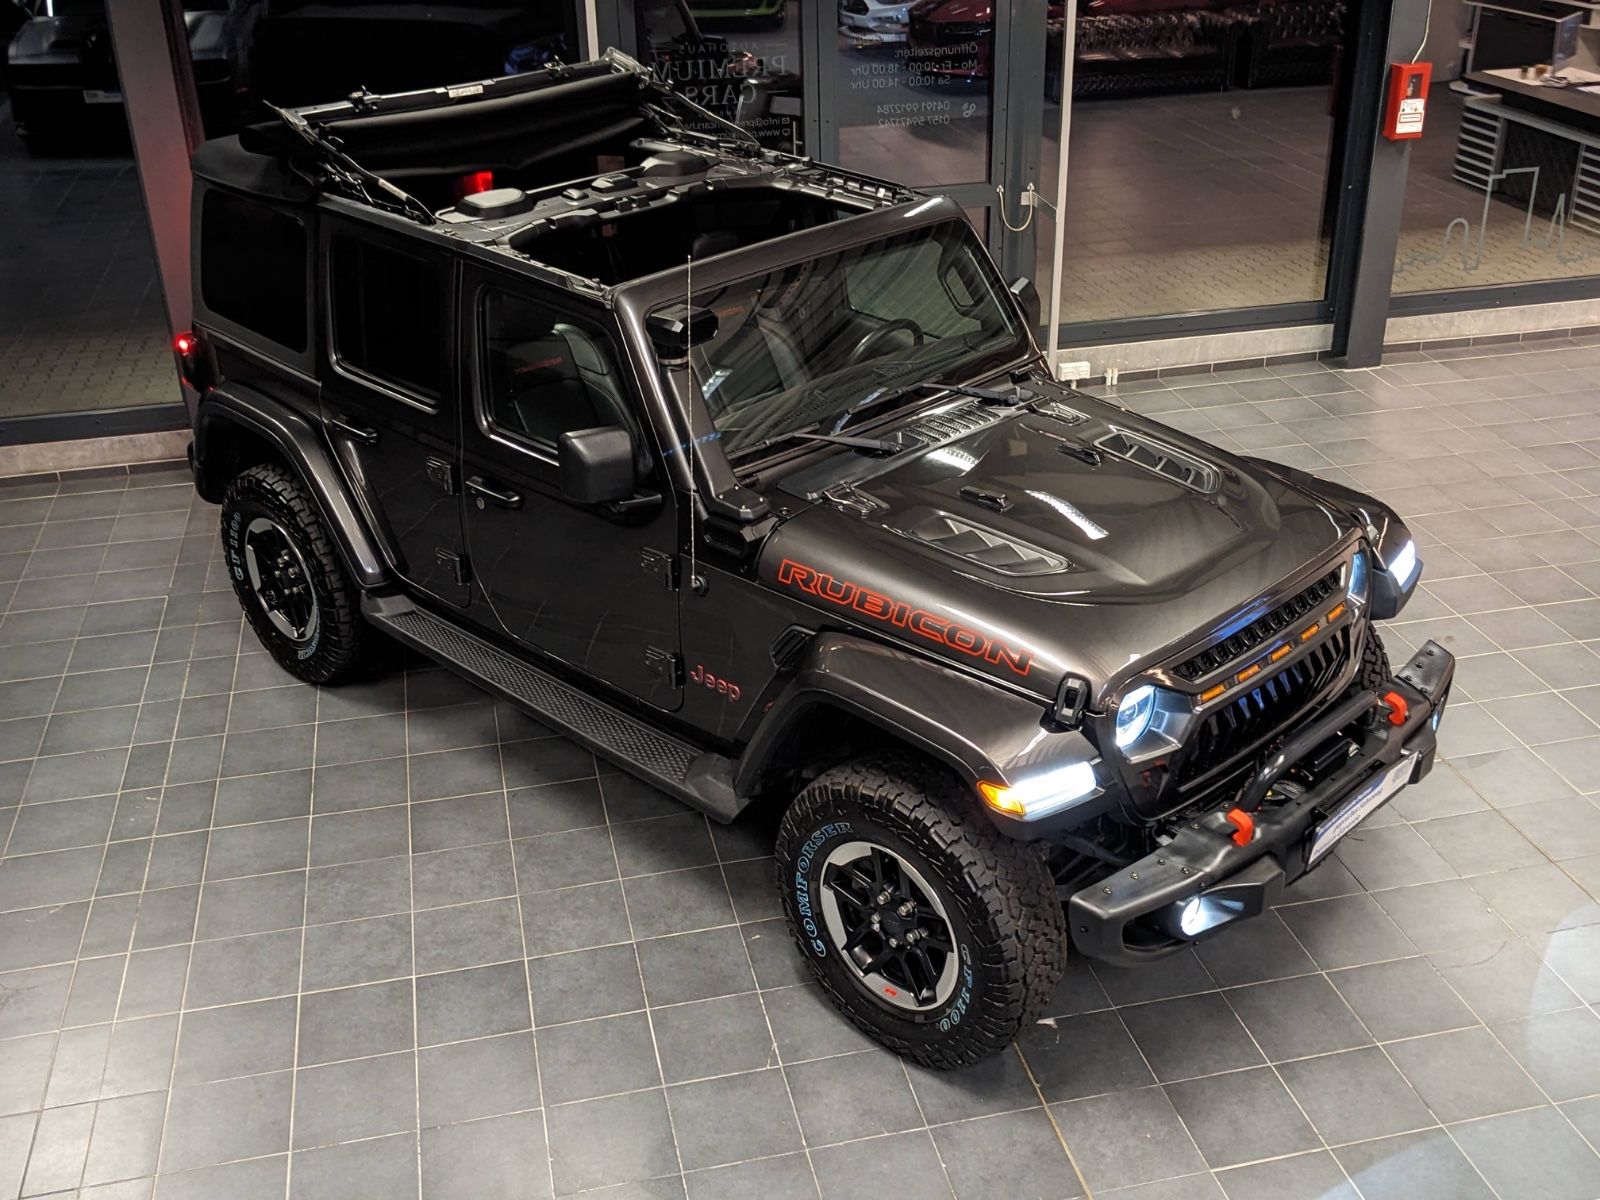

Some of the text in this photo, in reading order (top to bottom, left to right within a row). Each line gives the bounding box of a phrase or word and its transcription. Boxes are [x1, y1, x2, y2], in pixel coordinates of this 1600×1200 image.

[777, 559, 1034, 676] RUBICON
[690, 665, 742, 702] Jeep
[795, 821, 854, 958] COMFORSER
